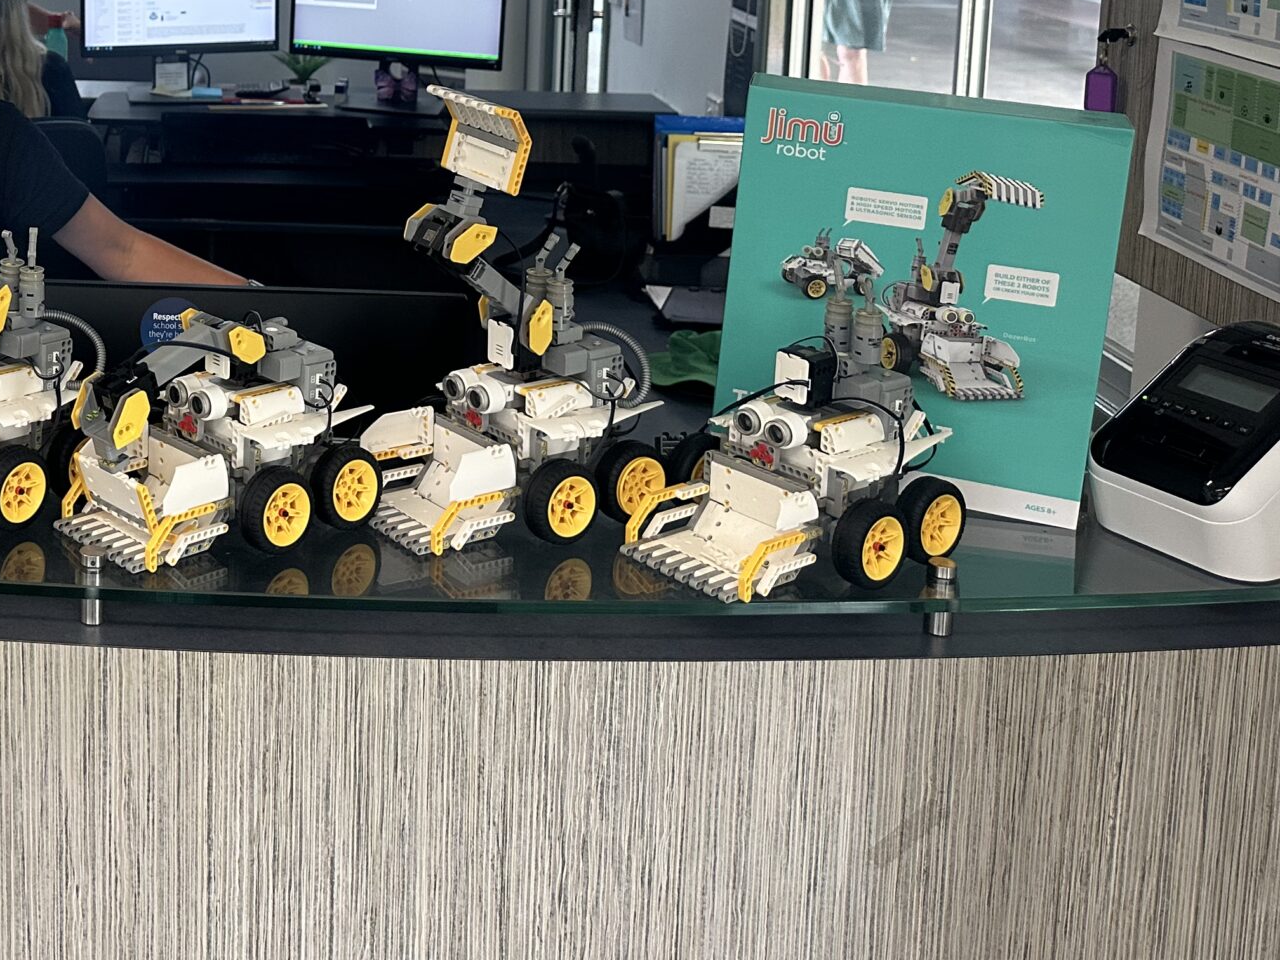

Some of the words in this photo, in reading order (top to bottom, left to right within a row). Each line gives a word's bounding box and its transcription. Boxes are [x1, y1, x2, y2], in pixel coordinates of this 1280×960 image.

[776, 142, 826, 161] robot
[855, 207, 895, 217] ULTRASONIC
[894, 207, 922, 215] MOTORS
[994, 272, 1016, 280] BUILD
[1016, 275, 1040, 283] EITHER
[993, 279, 1016, 287] THESE
[1022, 283, 1050, 292] ROBOTS
[153, 321, 177, 329] school
[148, 330, 173, 339] they're
[1025, 504, 1045, 513] AGES
[1047, 507, 1056, 515] 8+
